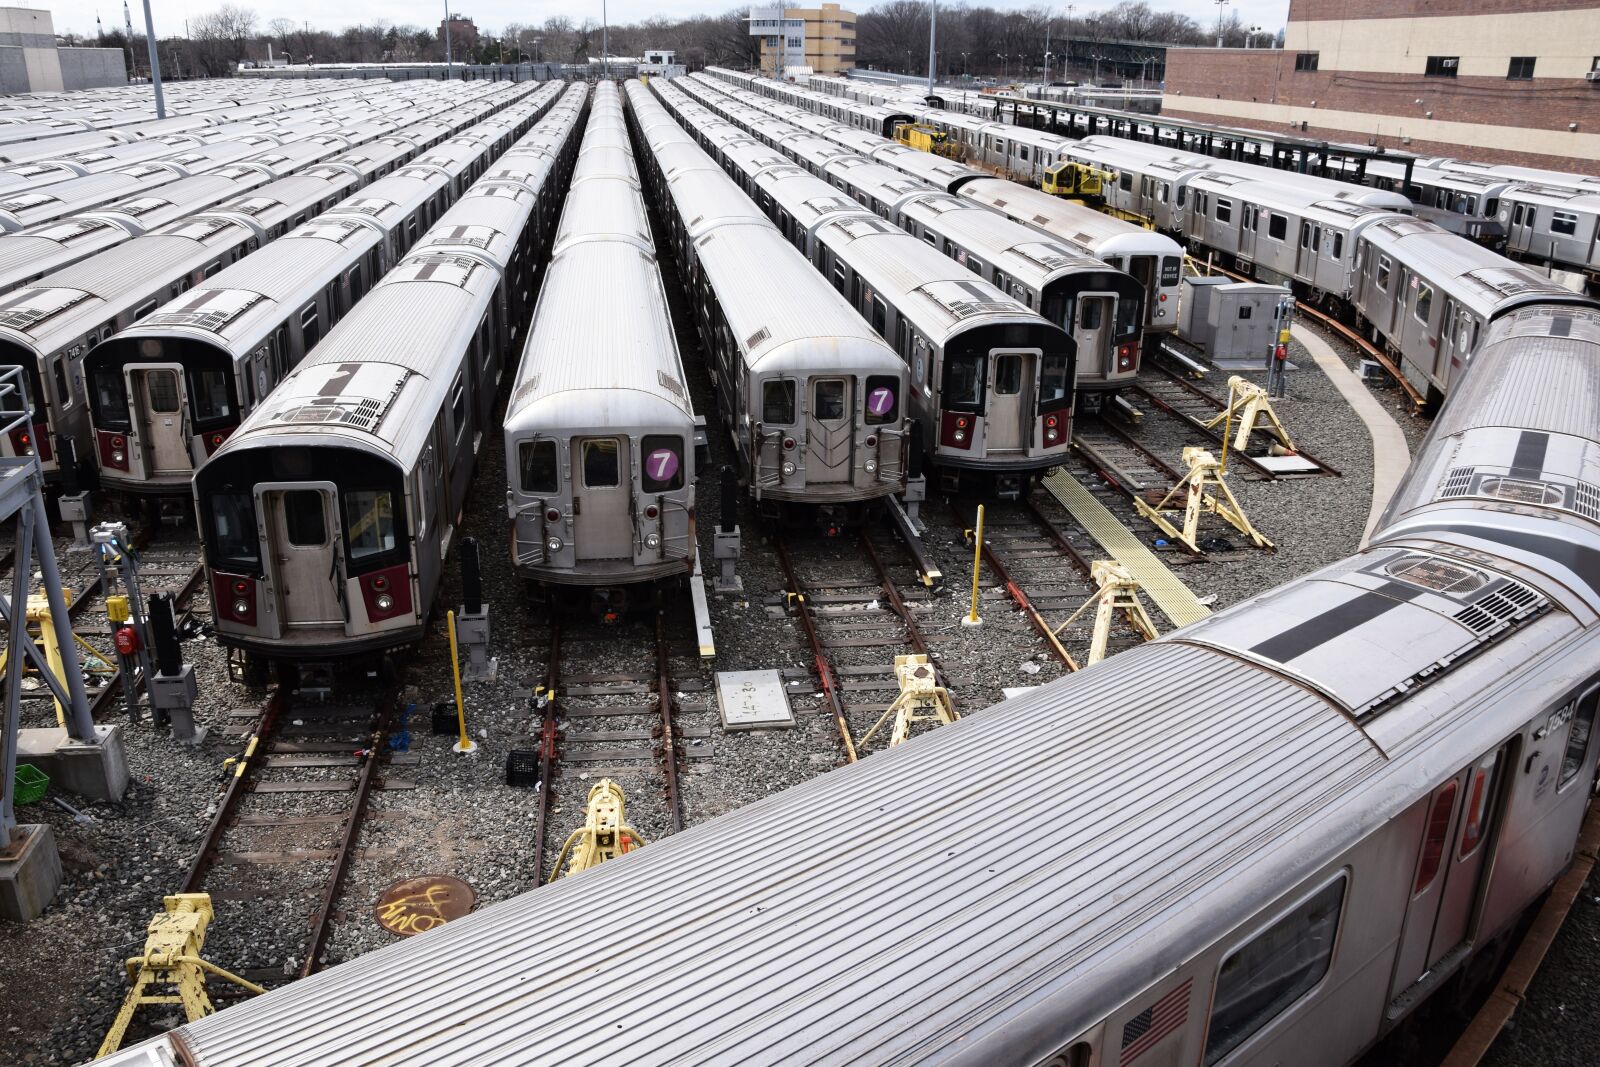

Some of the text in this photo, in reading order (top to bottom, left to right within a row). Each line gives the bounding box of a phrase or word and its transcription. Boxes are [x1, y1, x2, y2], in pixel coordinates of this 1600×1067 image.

[873, 390, 888, 412] 7
[653, 452, 671, 477] 7
[1547, 700, 1575, 736] 7584
